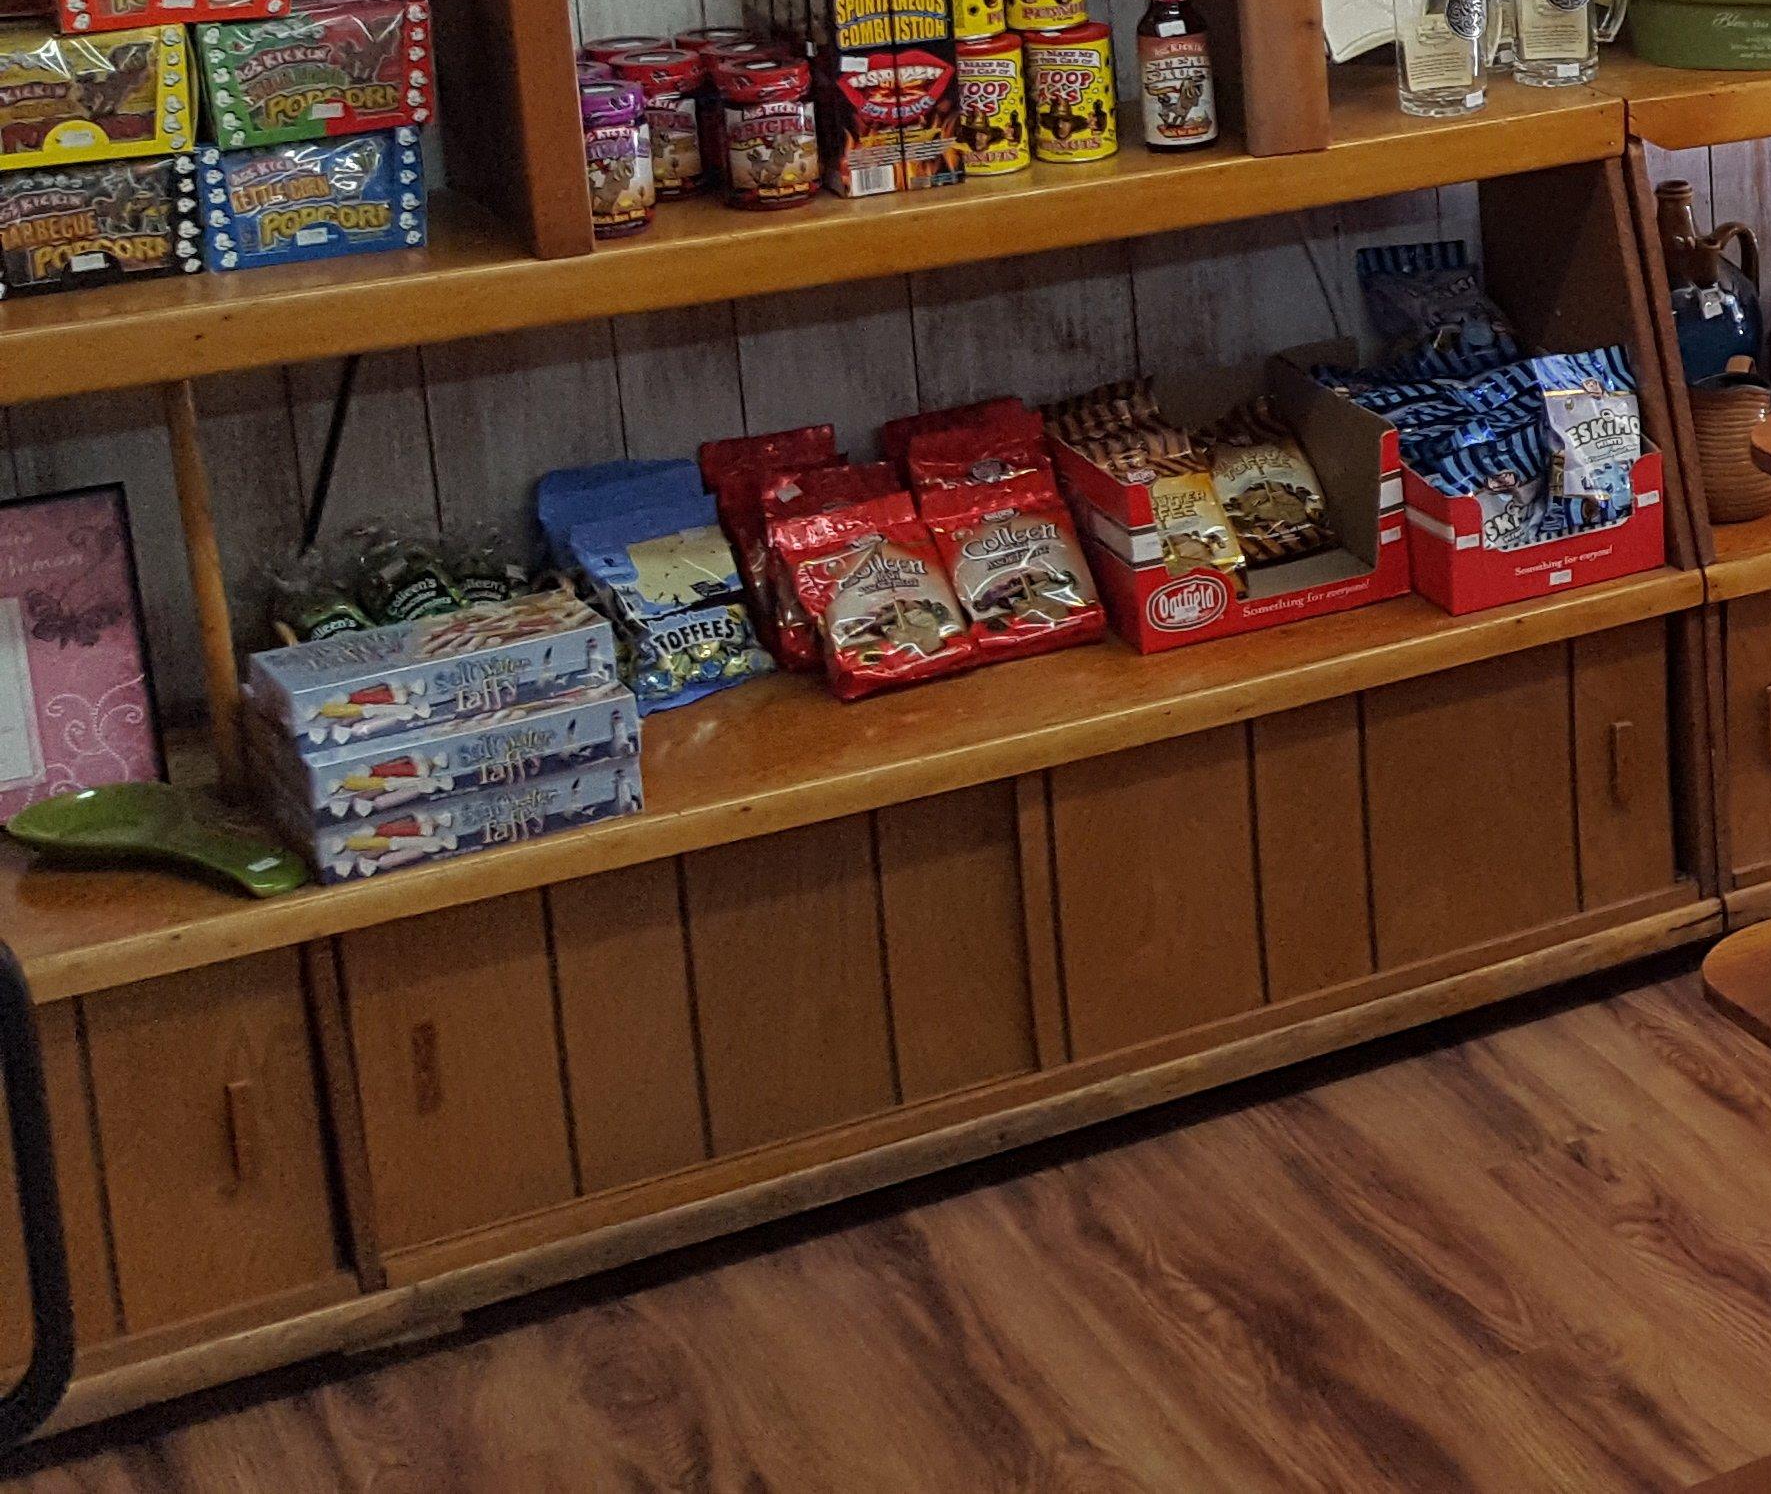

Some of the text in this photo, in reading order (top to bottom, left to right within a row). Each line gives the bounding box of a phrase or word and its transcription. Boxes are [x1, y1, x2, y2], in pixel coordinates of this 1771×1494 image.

[1038, 70, 1094, 87] HOOP
[963, 521, 1060, 560] Colleen
[1242, 591, 1305, 620] Something
[1306, 590, 1326, 606] for
[654, 620, 737, 655] TOFFEES
[456, 675, 520, 712] Taffy
[479, 751, 541, 786] Taffy
[483, 810, 546, 845] Taffy
